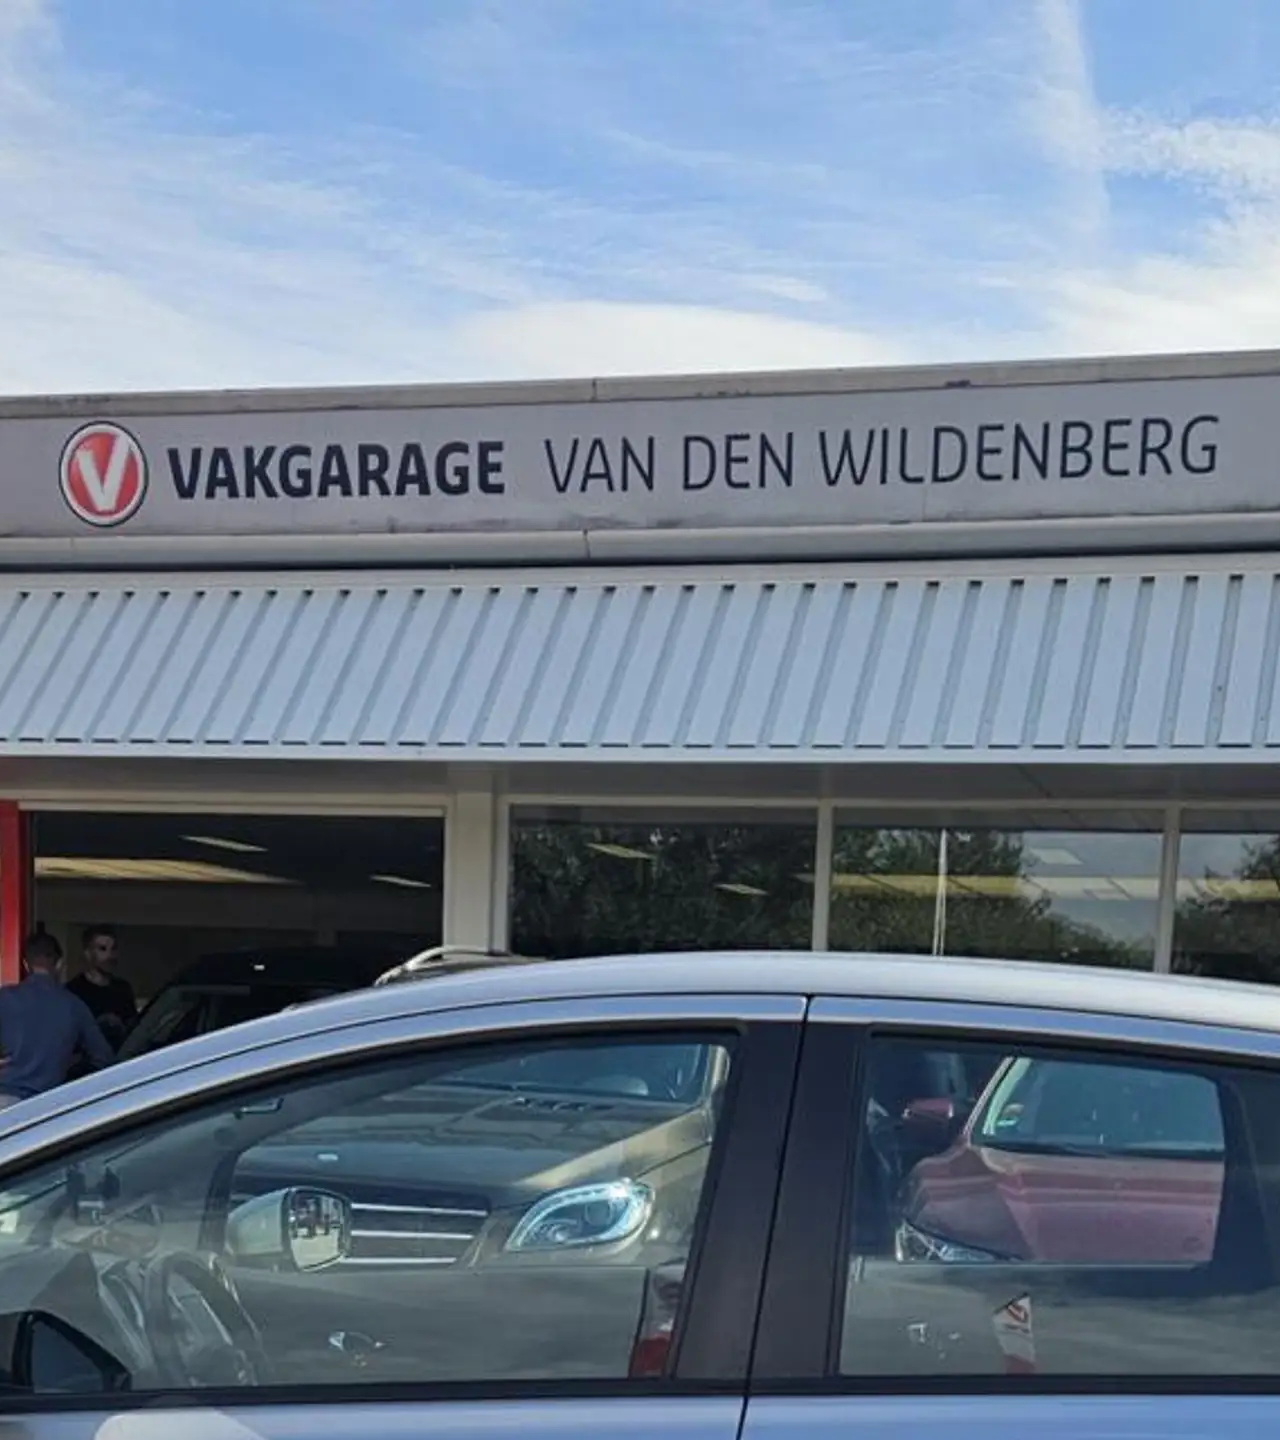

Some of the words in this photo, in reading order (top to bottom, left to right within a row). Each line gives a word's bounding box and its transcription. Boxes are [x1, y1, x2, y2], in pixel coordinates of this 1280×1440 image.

[168, 440, 507, 500] VAKGARAGE
[543, 435, 656, 494] VAN
[681, 430, 794, 491] DEN
[818, 414, 1220, 487] WILDENBERG
